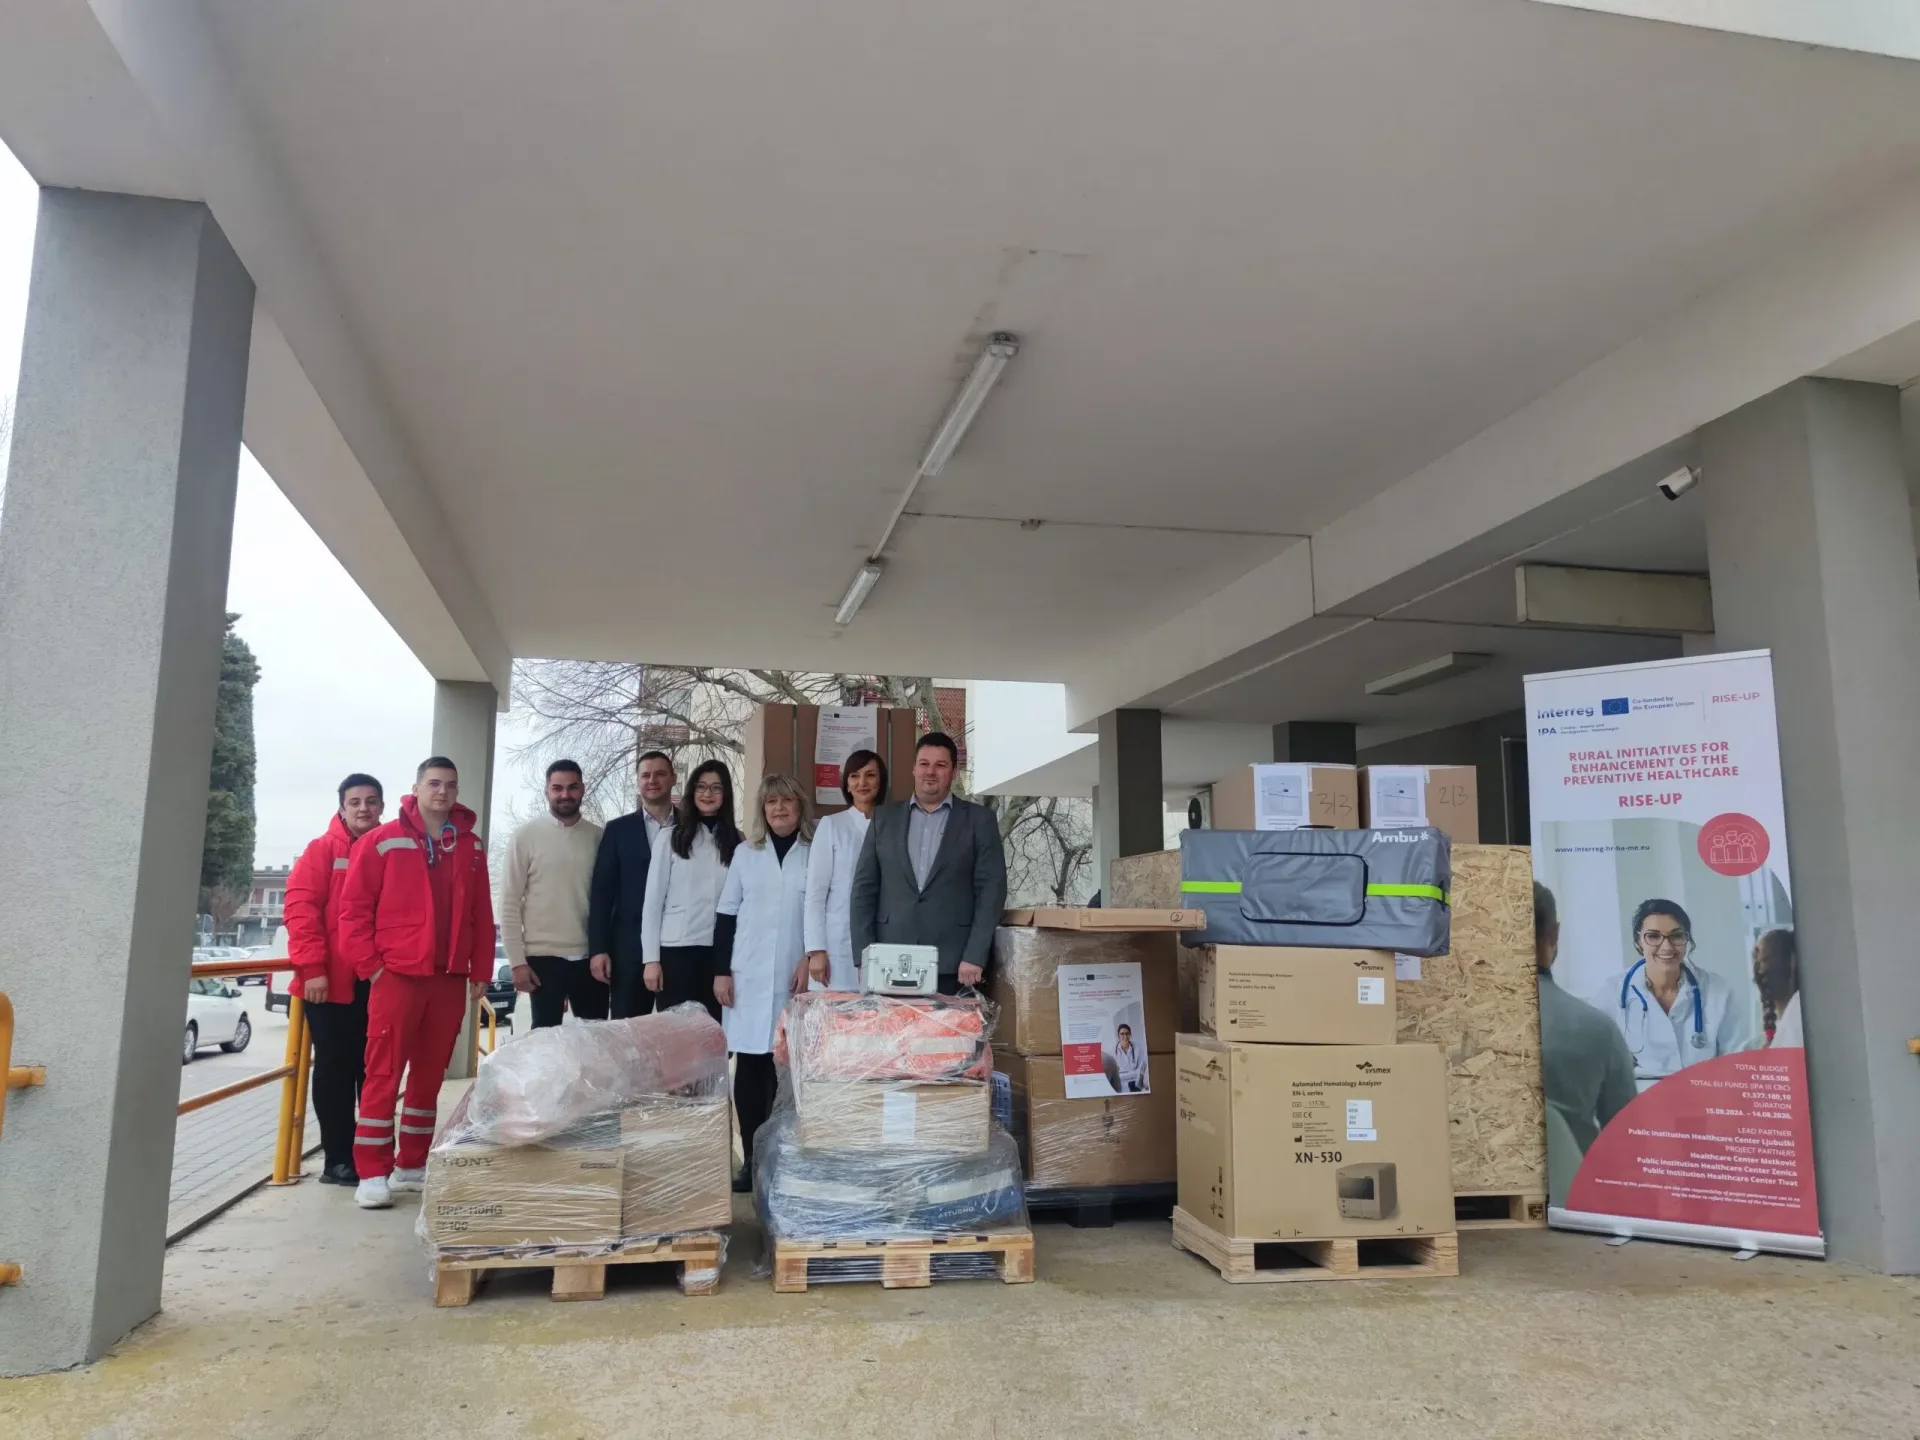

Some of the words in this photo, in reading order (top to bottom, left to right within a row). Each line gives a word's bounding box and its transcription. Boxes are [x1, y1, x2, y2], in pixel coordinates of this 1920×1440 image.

[1632, 696, 1665, 704] Co-funded
[1712, 691, 1760, 704] RISE-UP
[1538, 727, 1557, 736] IPA
[1569, 750, 1612, 762] RURAL
[1616, 743, 1697, 759] INITIATIVES
[1701, 741, 1729, 752] FOR
[1571, 757, 1674, 774] ENHANCEMENT
[1679, 756, 1698, 766] OF
[1701, 754, 1728, 765] THE
[1563, 772, 1644, 786] PREVENTIVE
[1647, 766, 1739, 781] HEALTHCARE
[1618, 792, 1682, 808] RISE-UP
[1372, 831, 1418, 844] Ambu
[1554, 845, 1650, 853] www.interreg-hr-ba-me.eu
[1759, 1064, 1788, 1072] BUDGET
[1292, 1080, 1322, 1088] Automated
[1324, 1080, 1356, 1088] Hematology
[1358, 1080, 1382, 1088] Analyzer
[1714, 1080, 1722, 1088] EU
[1724, 1081, 1748, 1089] FUNDS
[1754, 1102, 1792, 1110] DURATION
[1628, 1128, 1650, 1136] Public
[1652, 1130, 1690, 1139] Institution
[1692, 1133, 1733, 1142] Healthcare
[1734, 1136, 1760, 1144] Center
[1762, 1138, 1795, 1147] Ljubuški
[1758, 1128, 1792, 1136] PARTNER
[1294, 1151, 1342, 1164] XN-530
[1726, 1146, 1756, 1154] PROJECT
[1758, 1148, 1796, 1157] PARTNERS
[1690, 1152, 1732, 1162] Healthcare
[1733, 1156, 1759, 1164] Center
[1760, 1158, 1796, 1167] Metković
[1637, 1156, 1659, 1164] Public
[1660, 1158, 1700, 1168] Institution
[1701, 1162, 1742, 1172] Healthcare
[1744, 1166, 1770, 1174] Center
[1772, 1168, 1798, 1177] Zenica
[1643, 1166, 1665, 1174] Public
[1666, 1168, 1706, 1178] Institution
[1708, 1172, 1749, 1182] Healthcare
[1750, 1176, 1776, 1185] Center
[1778, 1178, 1798, 1187] Tivat
